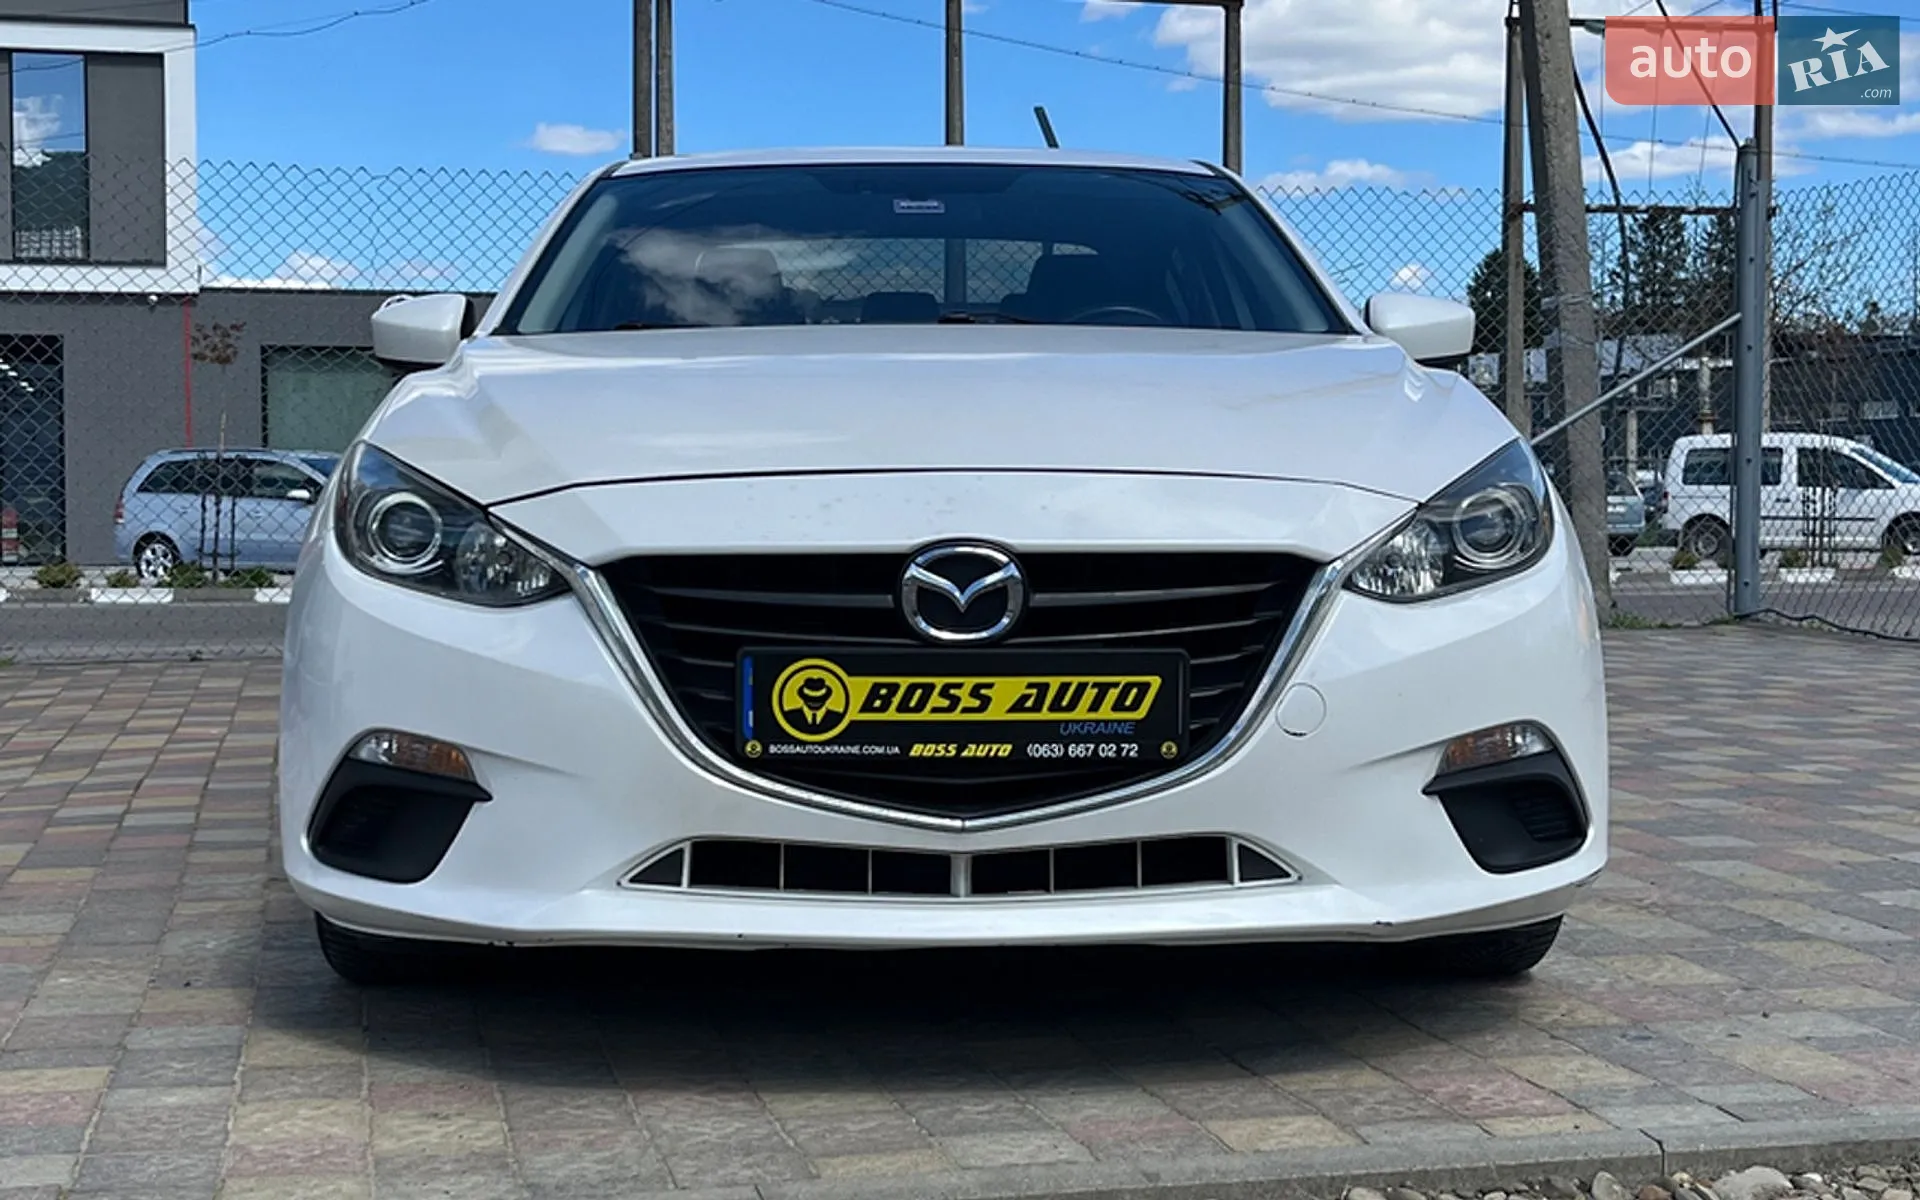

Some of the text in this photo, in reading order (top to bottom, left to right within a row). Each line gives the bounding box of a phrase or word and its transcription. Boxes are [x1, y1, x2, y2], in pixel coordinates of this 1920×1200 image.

[859, 682, 1151, 714] BOSS AUTO
[1060, 722, 1135, 735] UKRAINE
[769, 744, 901, 755] BOSSAUTOUKRAINE.COM.UA
[909, 744, 1012, 757] BOSS AUTO
[1027, 743, 1138, 758] (063) 667 02 72
